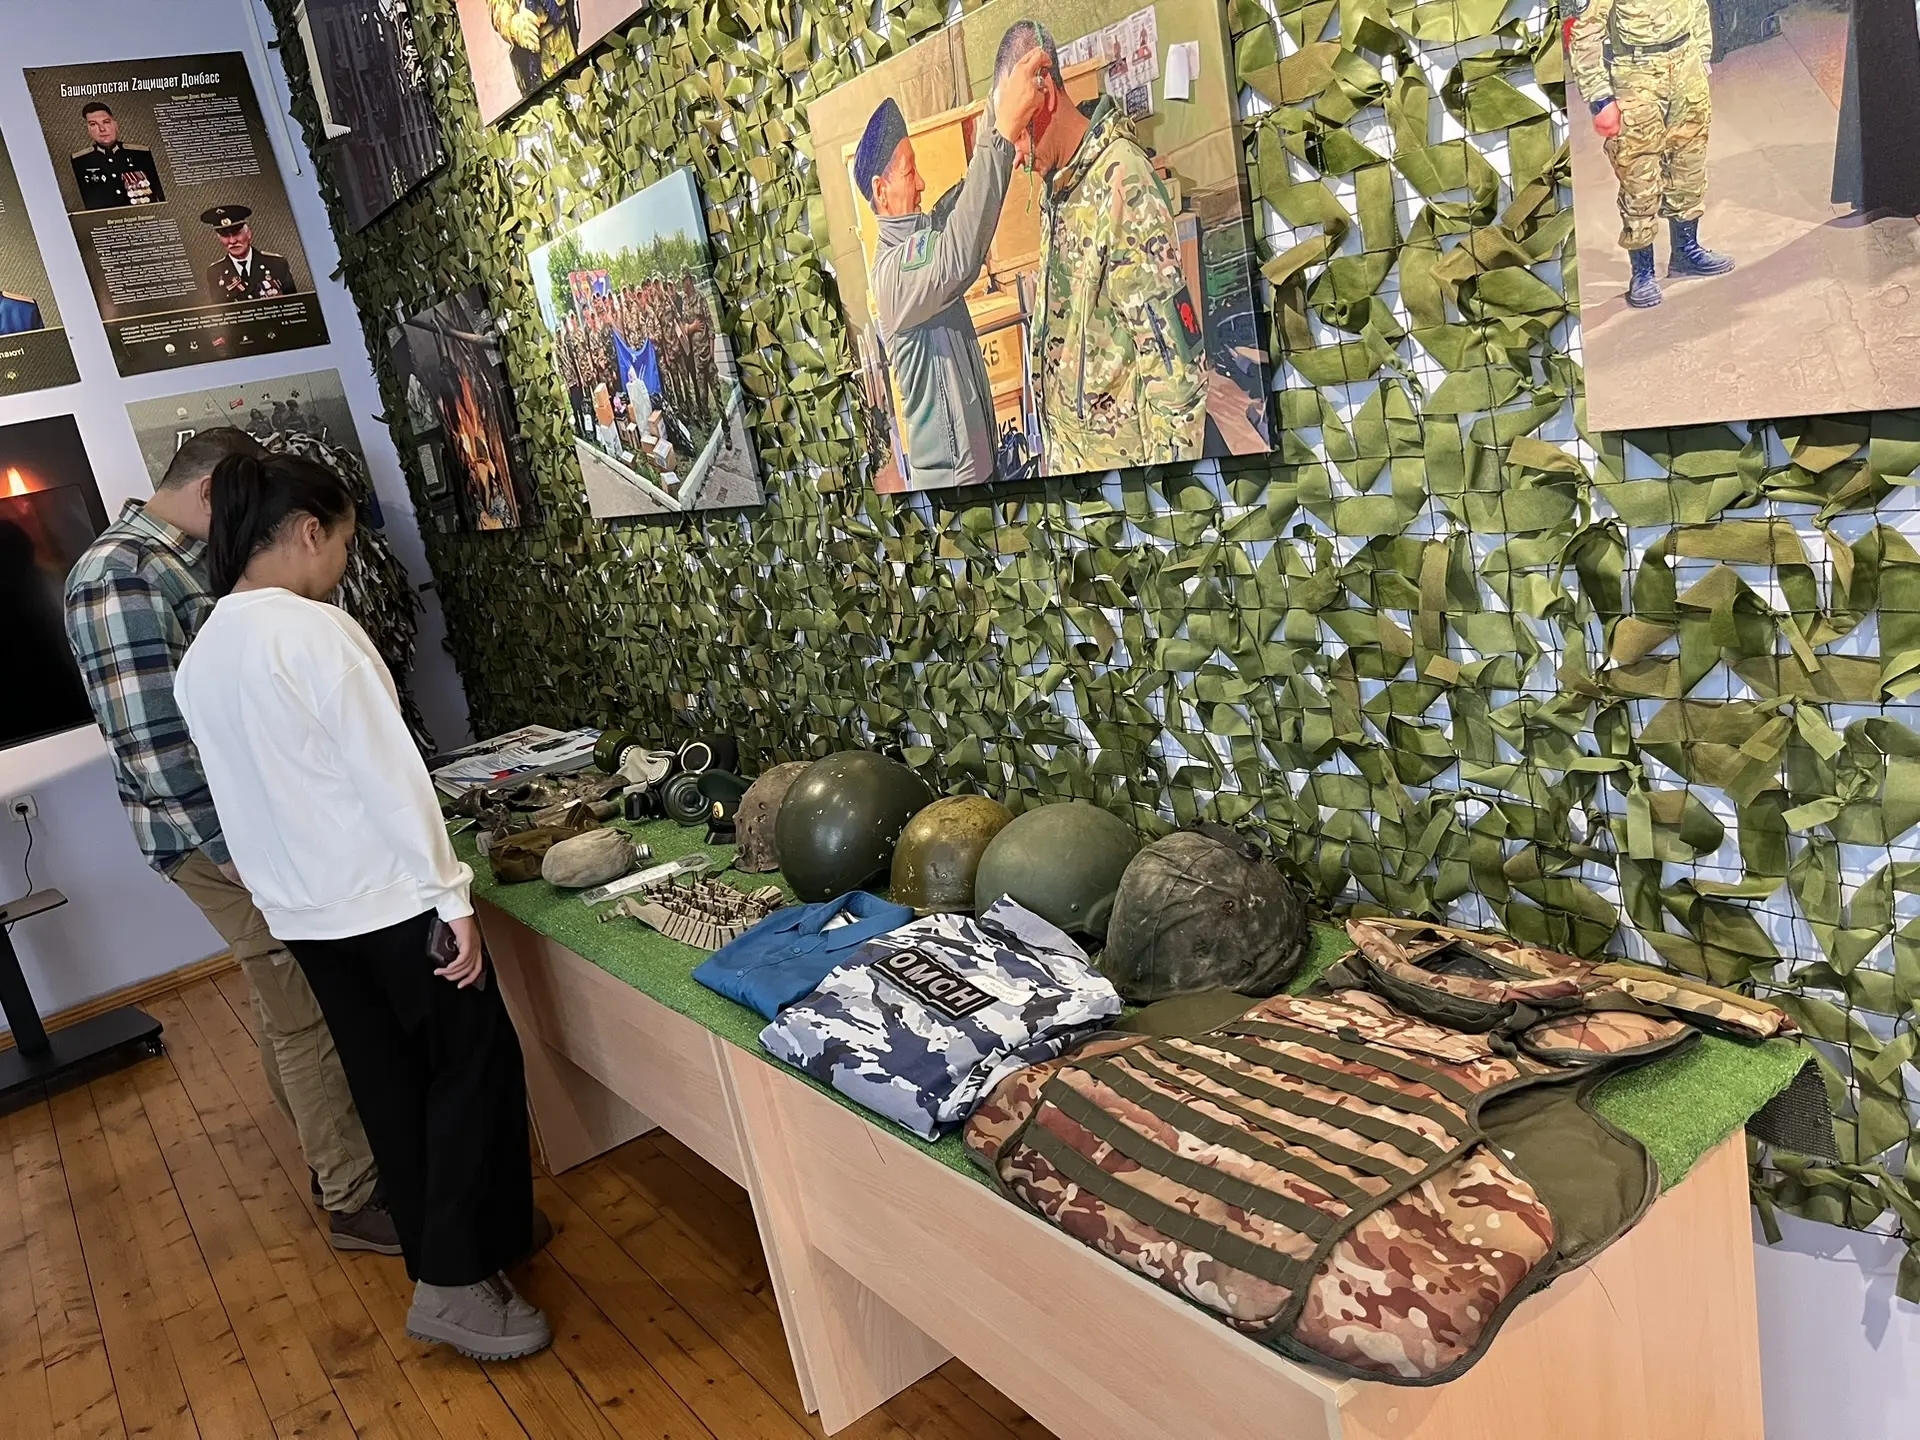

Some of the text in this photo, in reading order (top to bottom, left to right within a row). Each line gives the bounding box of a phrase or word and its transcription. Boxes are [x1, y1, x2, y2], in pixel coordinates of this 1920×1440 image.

[60, 72, 220, 97] Башкортостан Zащищает Донбасс
[889, 952, 983, 1008] ОМОН
